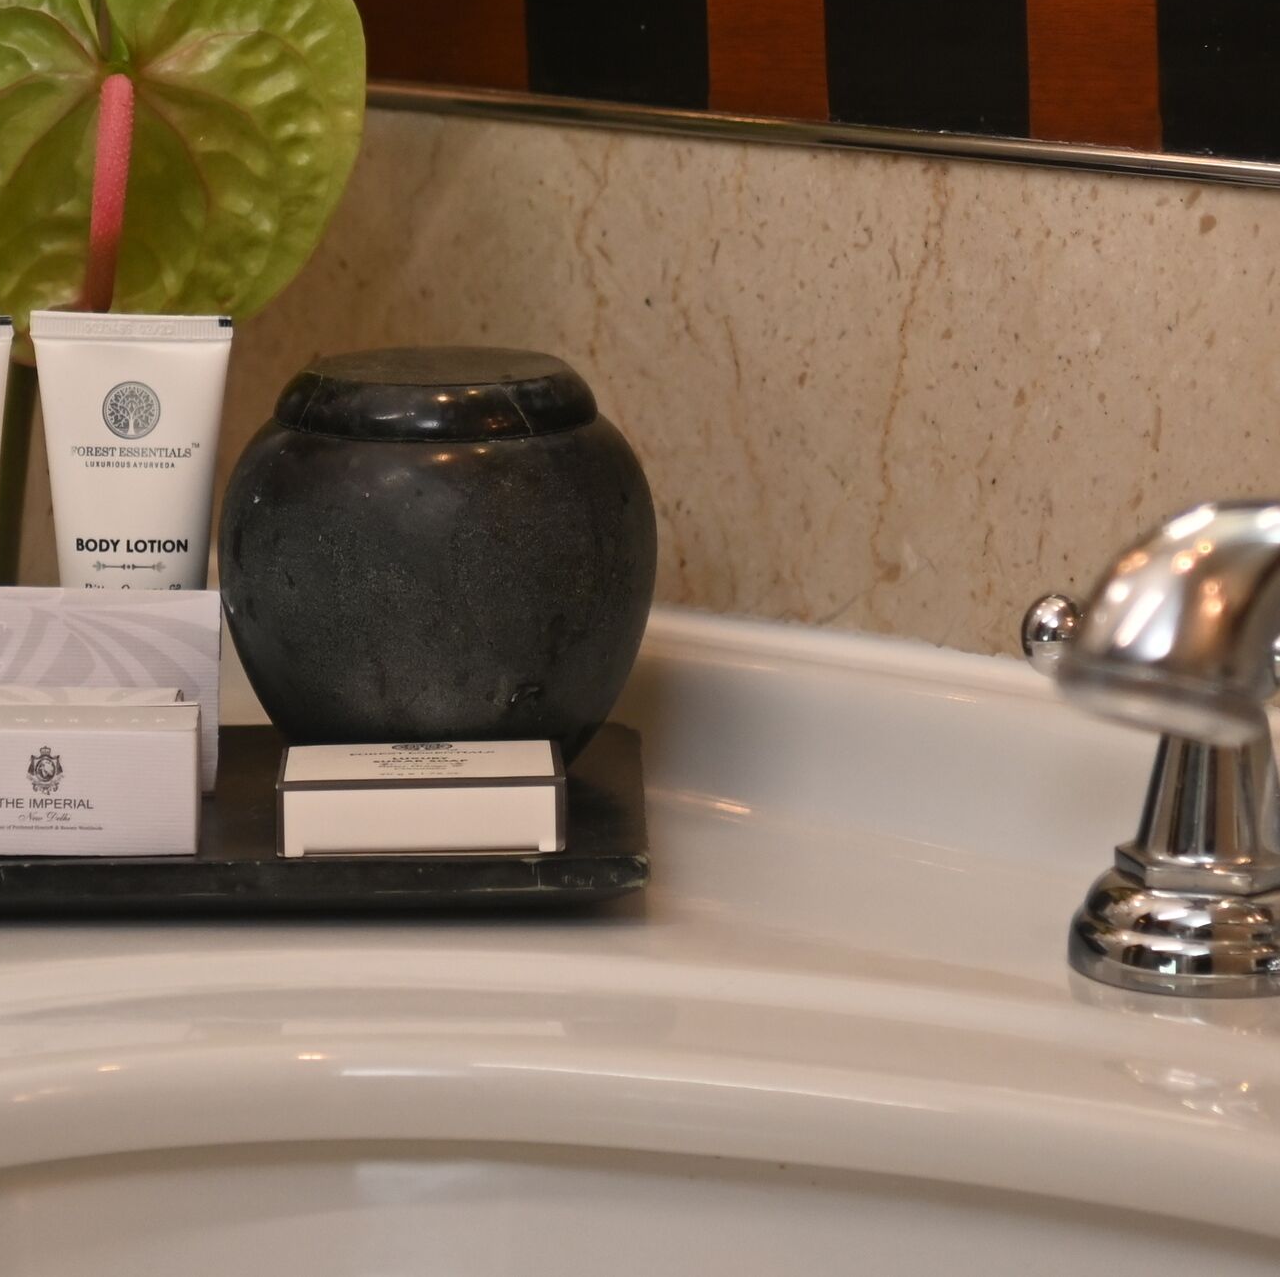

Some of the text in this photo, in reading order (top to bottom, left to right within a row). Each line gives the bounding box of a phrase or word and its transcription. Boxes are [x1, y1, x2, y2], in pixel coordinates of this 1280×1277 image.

[71, 446, 116, 458] FOREST
[132, 461, 175, 469] AYURVEDA
[76, 538, 189, 553] BODY LOTION
[28, 798, 94, 810] IMPERIAL
[18, 811, 71, 823] New Delhi
